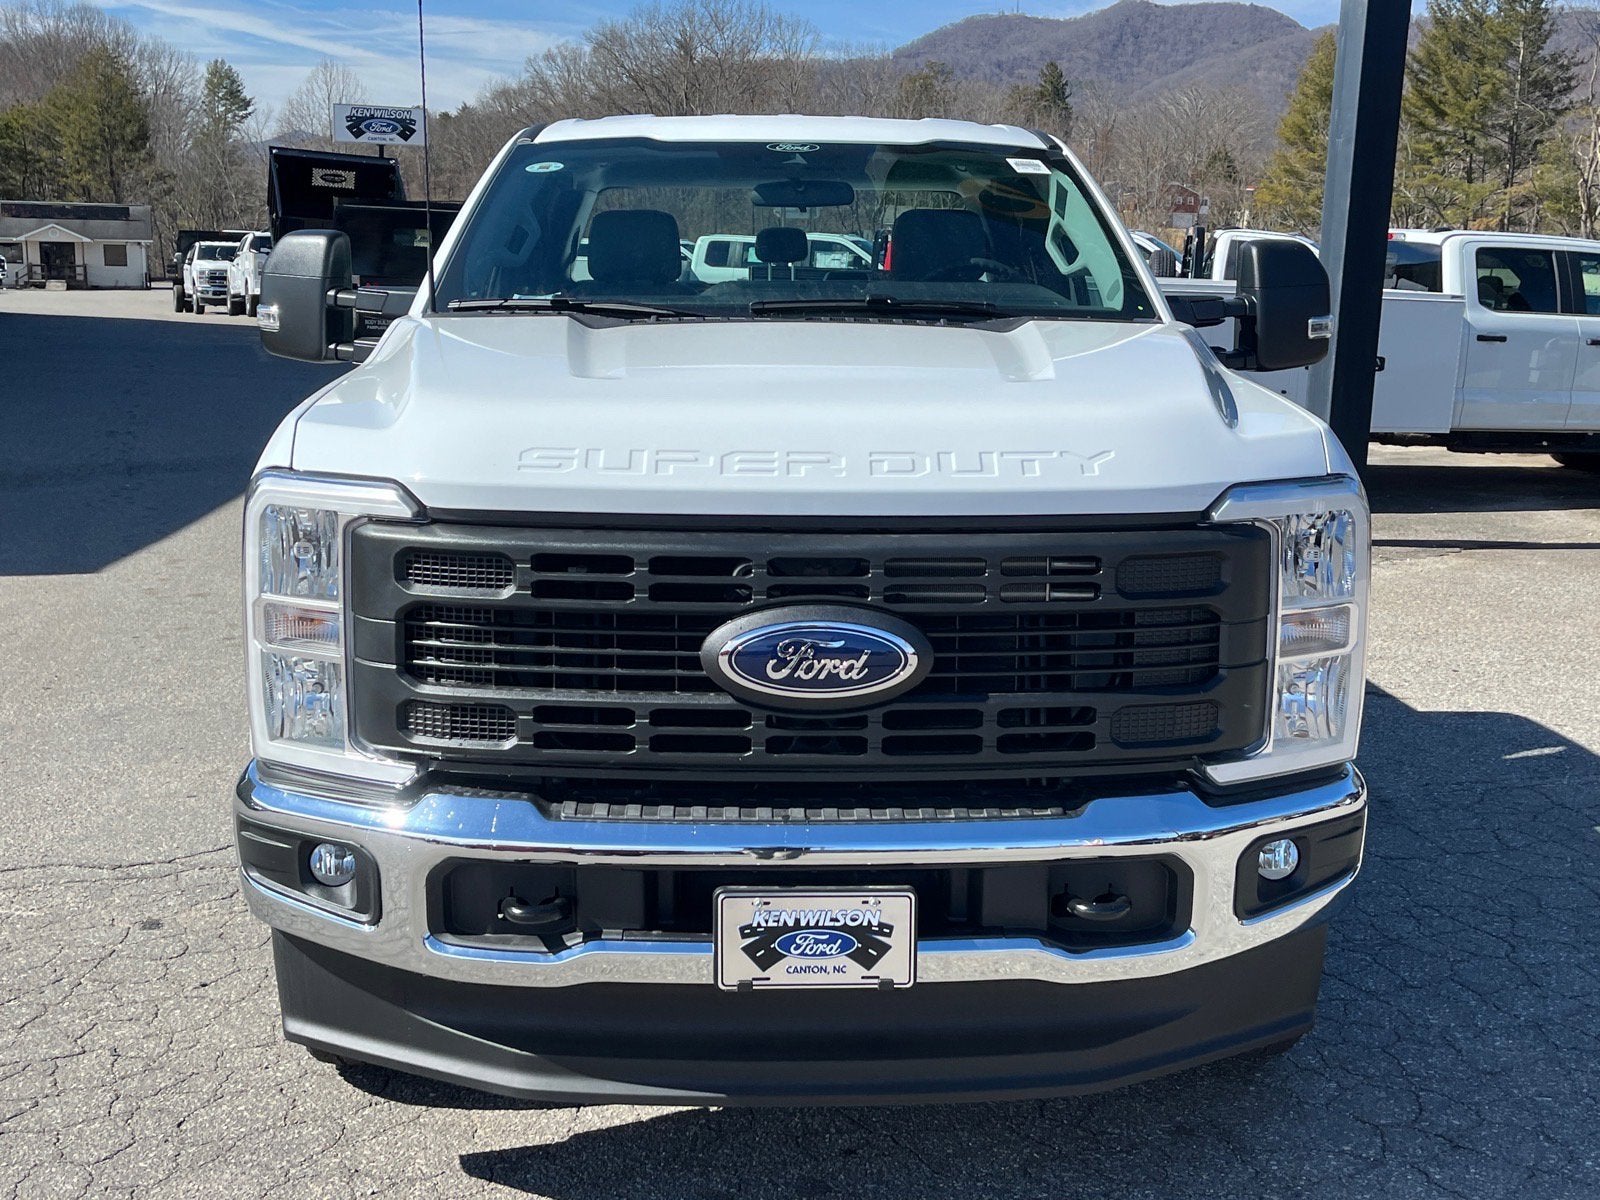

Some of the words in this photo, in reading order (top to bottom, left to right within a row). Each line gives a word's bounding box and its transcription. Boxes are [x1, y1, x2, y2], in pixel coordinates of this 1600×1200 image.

[350, 108, 372, 117] KEN
[374, 108, 411, 119] WILSON
[369, 122, 393, 132] Ford
[776, 143, 810, 151] Ford
[517, 446, 847, 477] SUPER
[868, 449, 1116, 477] DUTY
[766, 637, 872, 680] Ford
[751, 908, 800, 928] KEN
[799, 908, 882, 927] WILSON
[789, 932, 842, 956] Ford
[785, 964, 830, 976] CANTON,
[832, 964, 847, 975] NC
